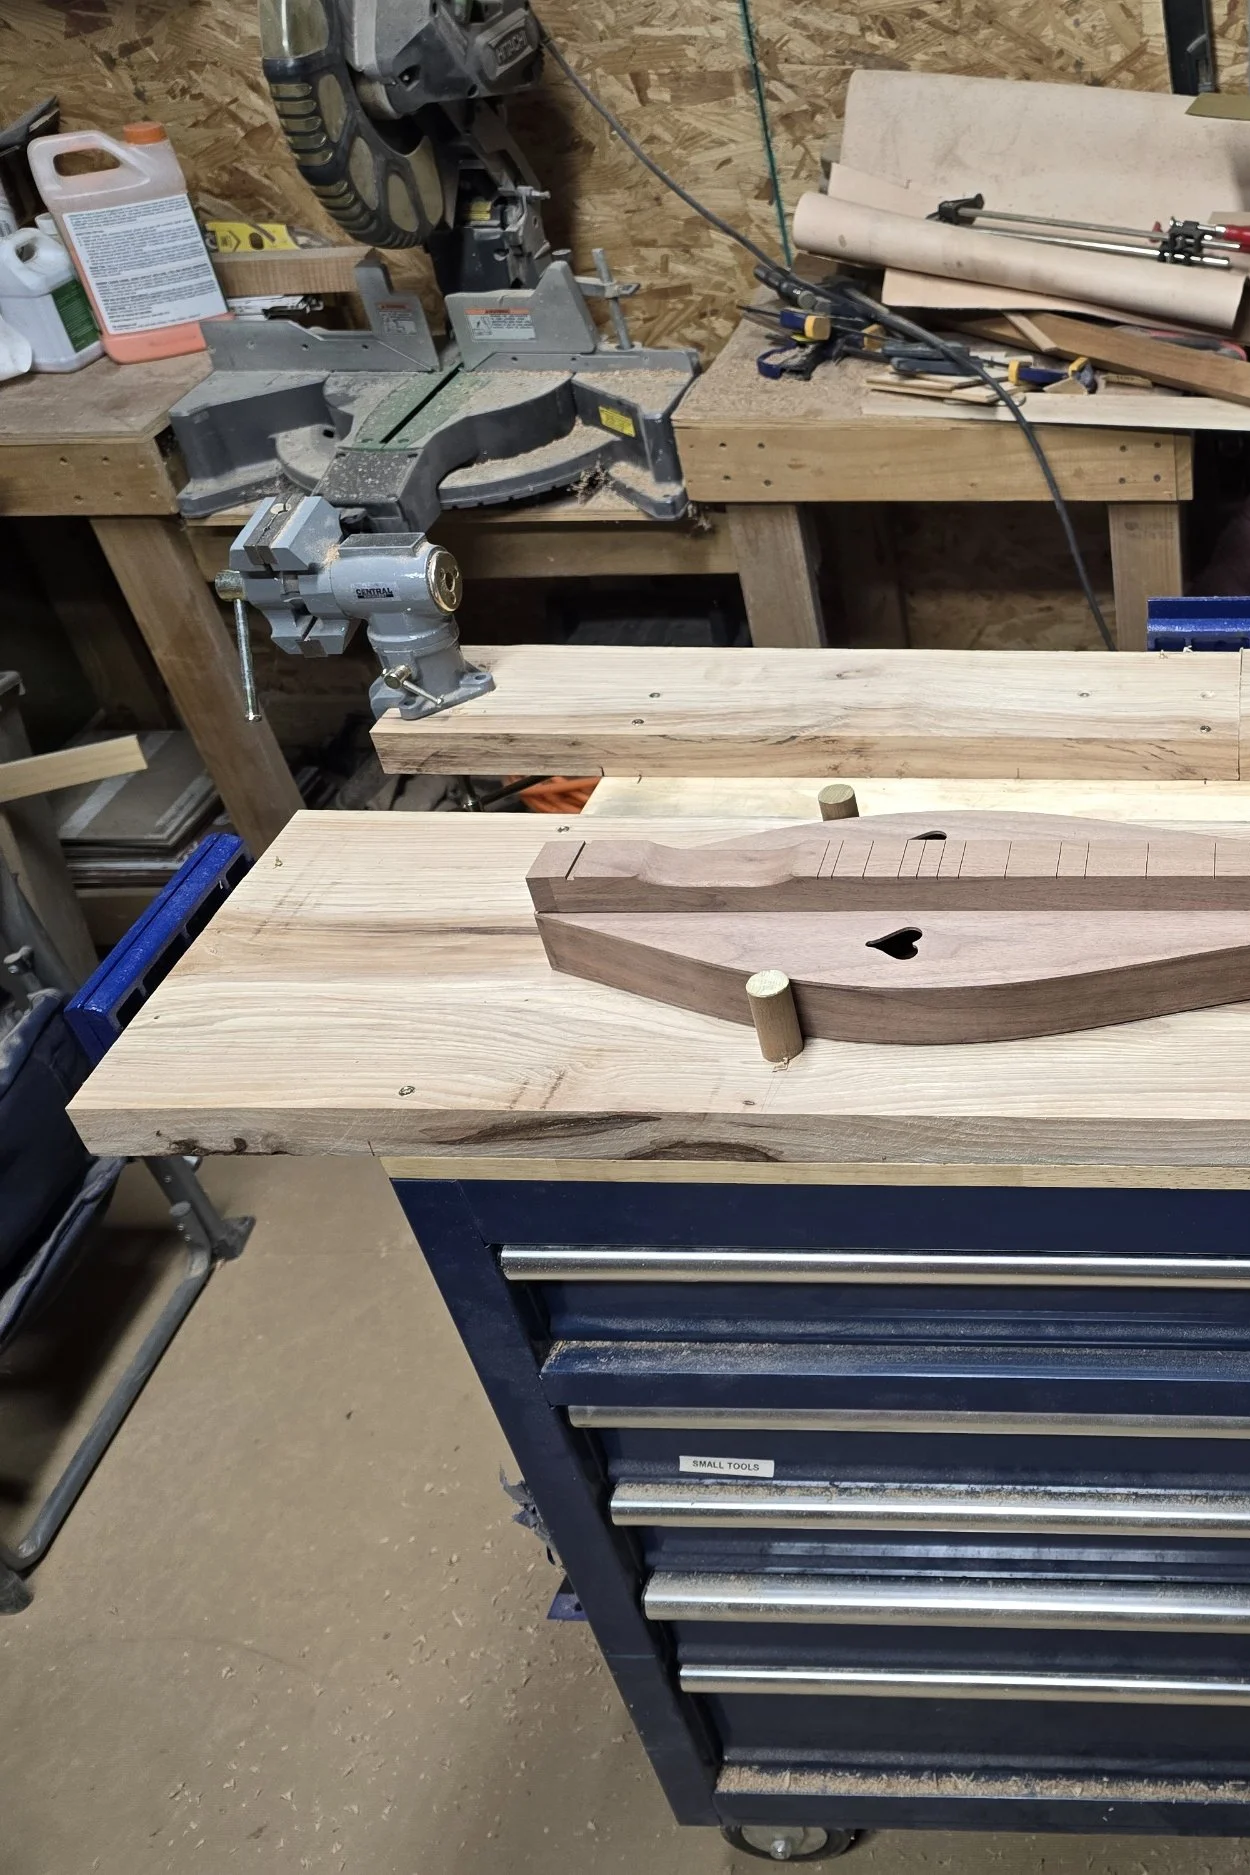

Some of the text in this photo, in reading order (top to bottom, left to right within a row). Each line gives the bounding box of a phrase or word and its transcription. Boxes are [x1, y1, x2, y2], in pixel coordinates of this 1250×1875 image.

[355, 587, 393, 596] CENTRAL
[692, 1460, 760, 1472] SMALL TOOLS
